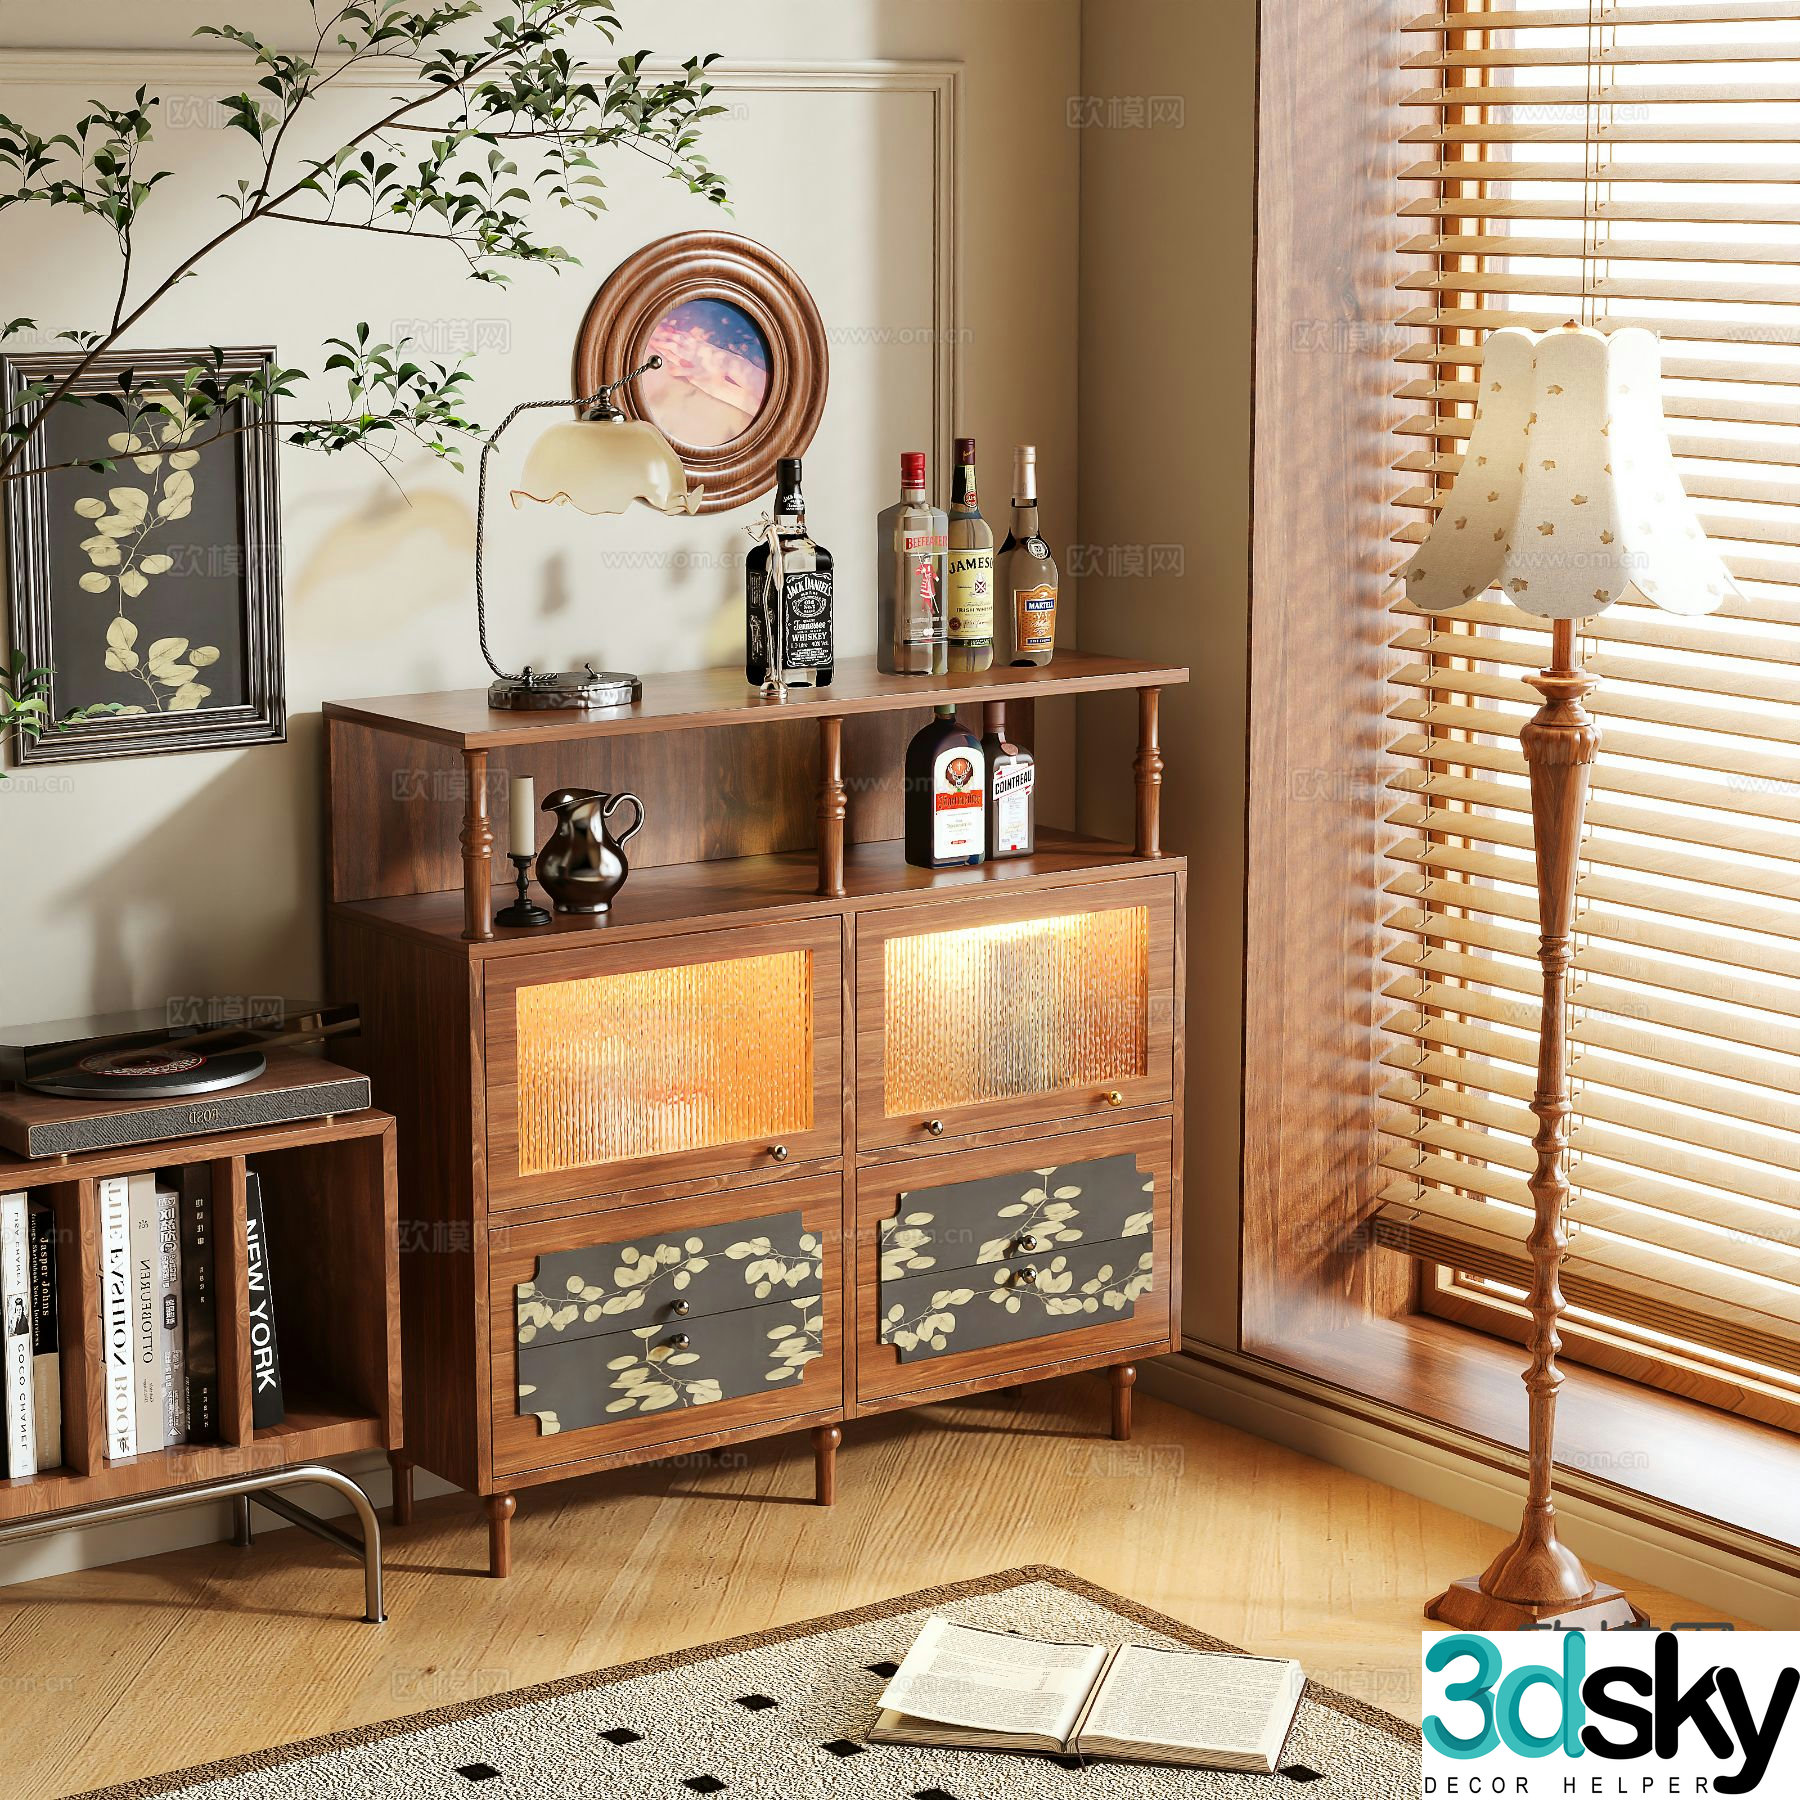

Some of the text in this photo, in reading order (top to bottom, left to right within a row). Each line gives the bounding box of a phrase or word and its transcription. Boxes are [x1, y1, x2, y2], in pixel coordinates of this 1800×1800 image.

[787, 580, 804, 599] JACK
[792, 632, 828, 642] WHISKEY
[995, 770, 1032, 795] COINTREAU
[39, 1237, 50, 1316] Jasper Johns
[246, 1218, 277, 1394] NEW YORK
